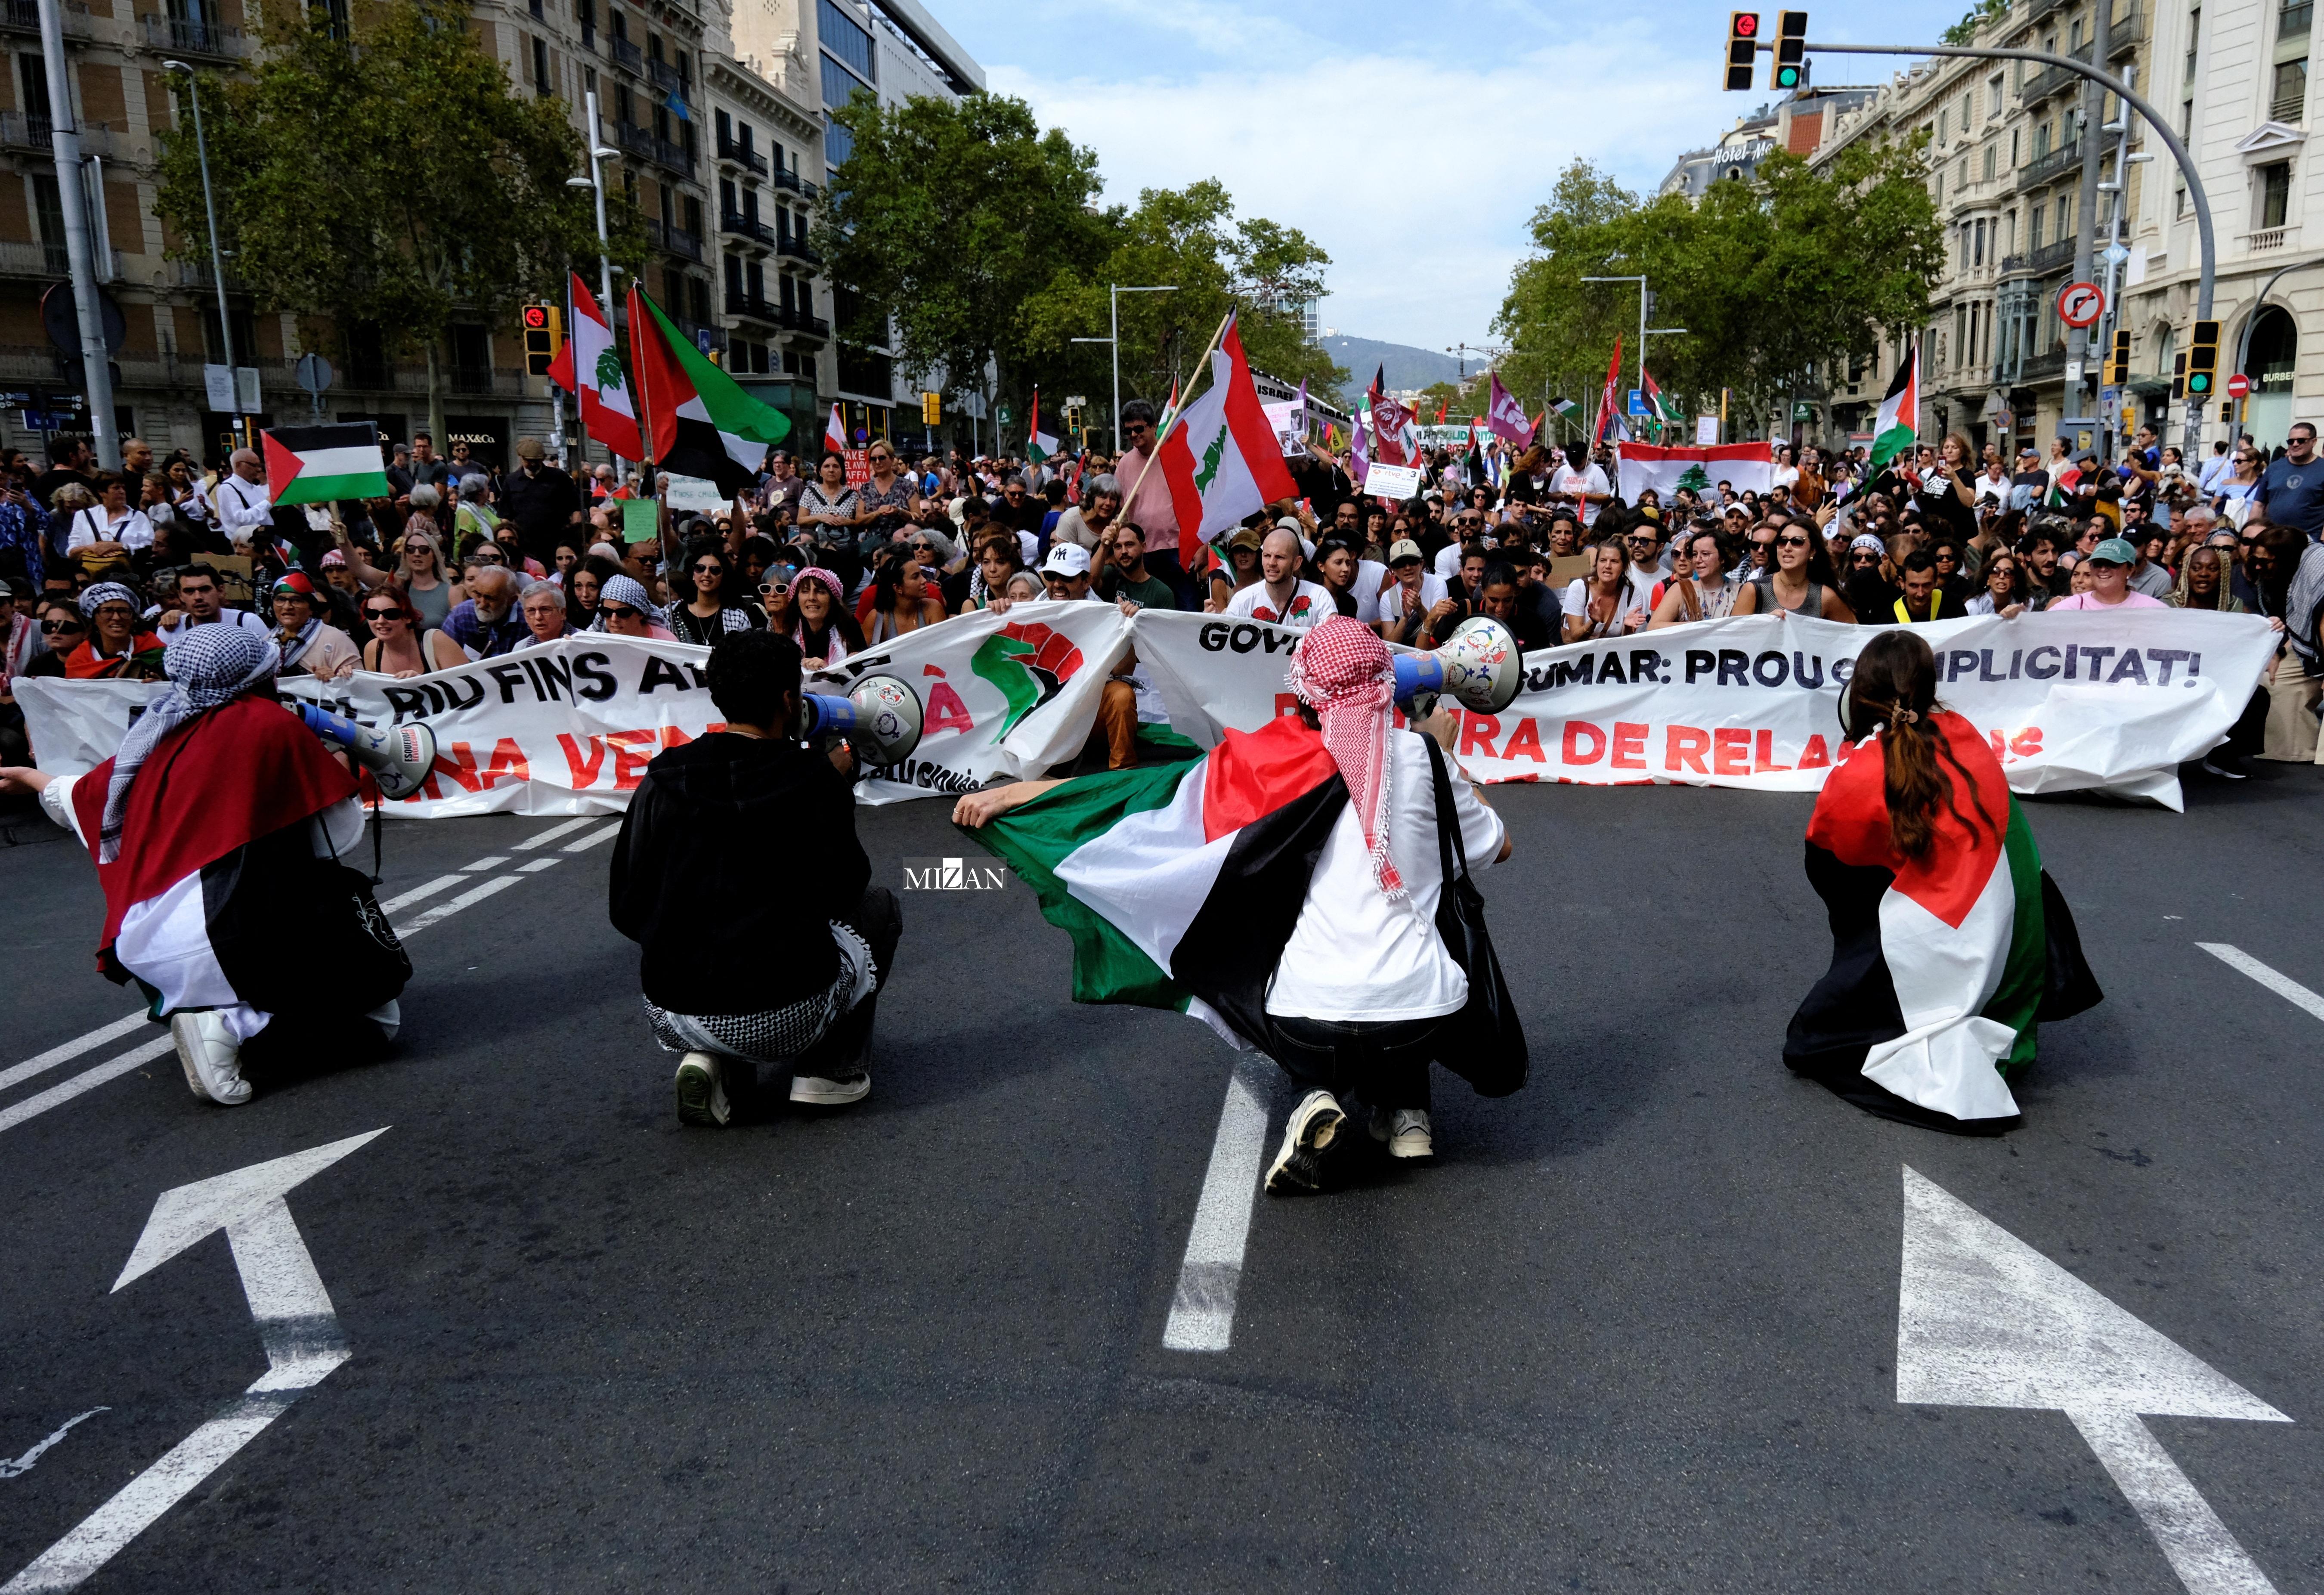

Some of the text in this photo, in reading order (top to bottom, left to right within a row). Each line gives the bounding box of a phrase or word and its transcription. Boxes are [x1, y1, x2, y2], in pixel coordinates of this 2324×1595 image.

[1712, 144, 1747, 168] Hotel
[846, 471, 867, 479] AFFA
[1400, 542, 1408, 554] P
[485, 651, 619, 707] FINS
[1520, 650, 1671, 691] UMAR:
[1685, 649, 1824, 689] PROU
[1562, 721, 1649, 769] DE
